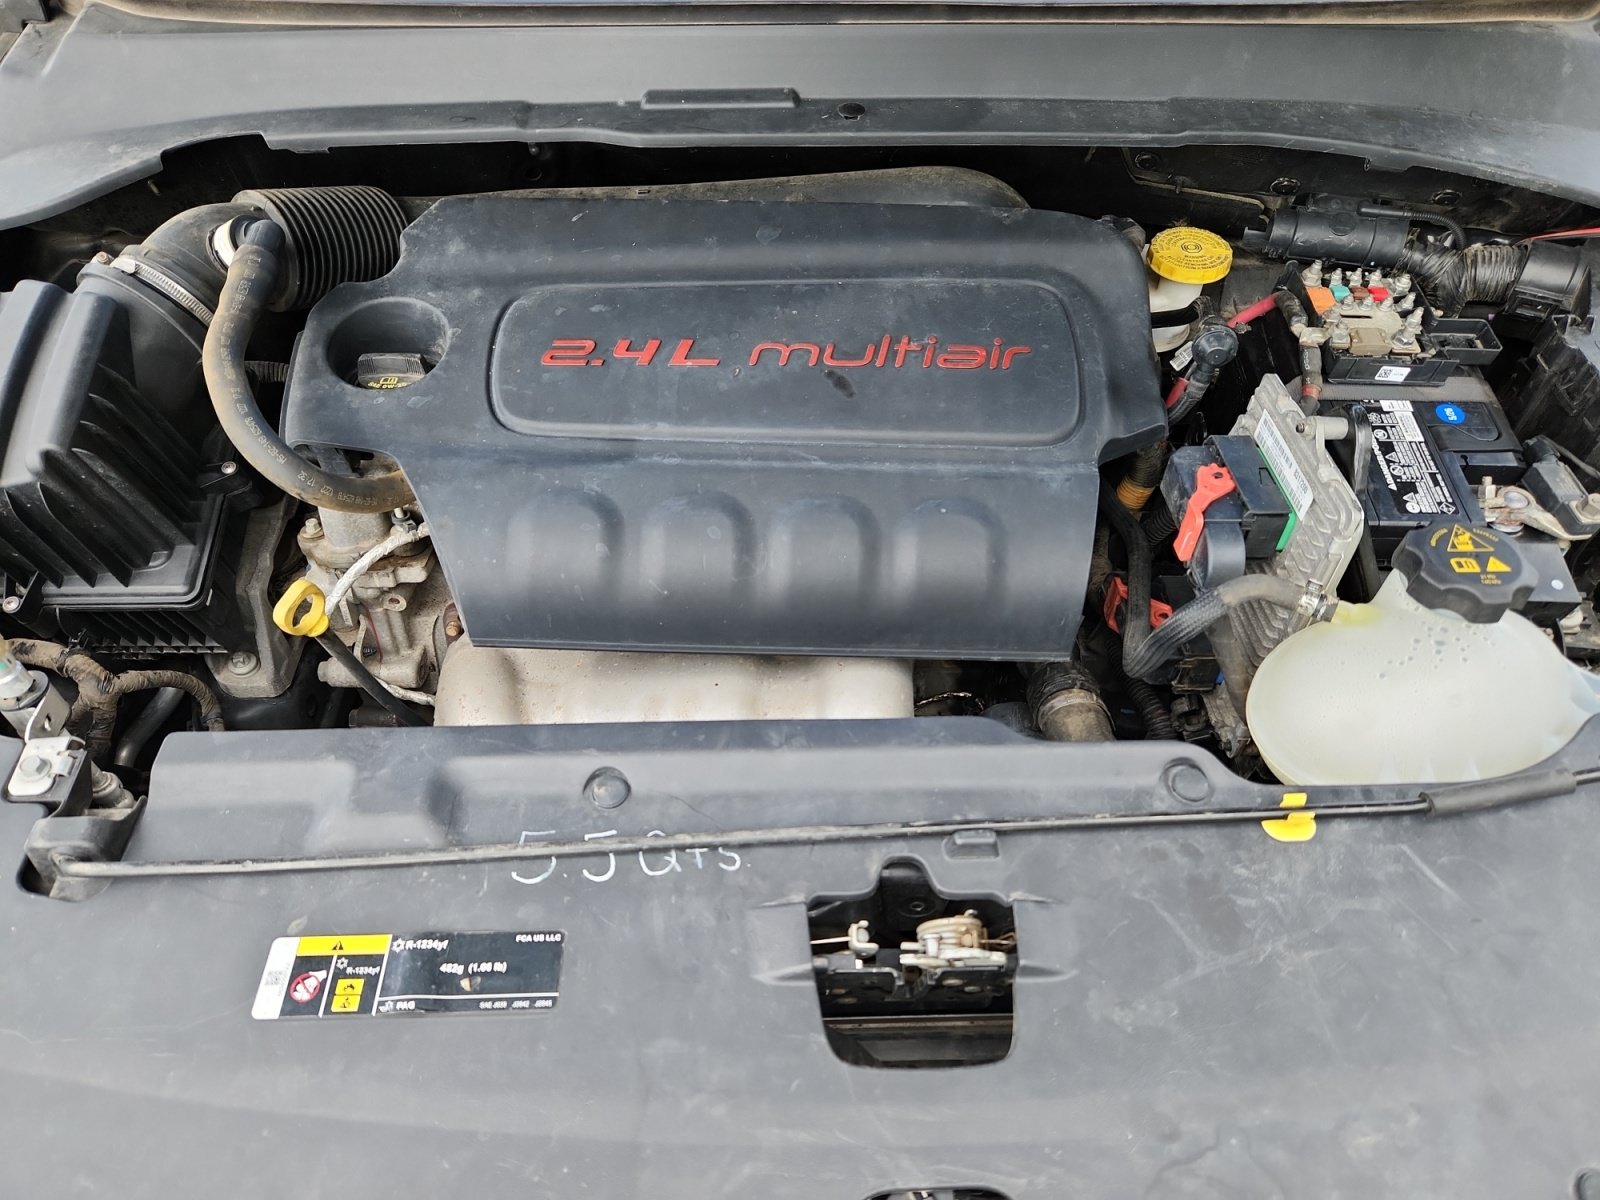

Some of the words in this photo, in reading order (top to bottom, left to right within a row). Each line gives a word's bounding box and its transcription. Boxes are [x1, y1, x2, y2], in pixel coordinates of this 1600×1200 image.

[748, 334, 1031, 370] multiair
[515, 934, 533, 943] FCA
[533, 933, 545, 942] US
[545, 933, 562, 942] LLC
[406, 939, 449, 951] R-1234yf
